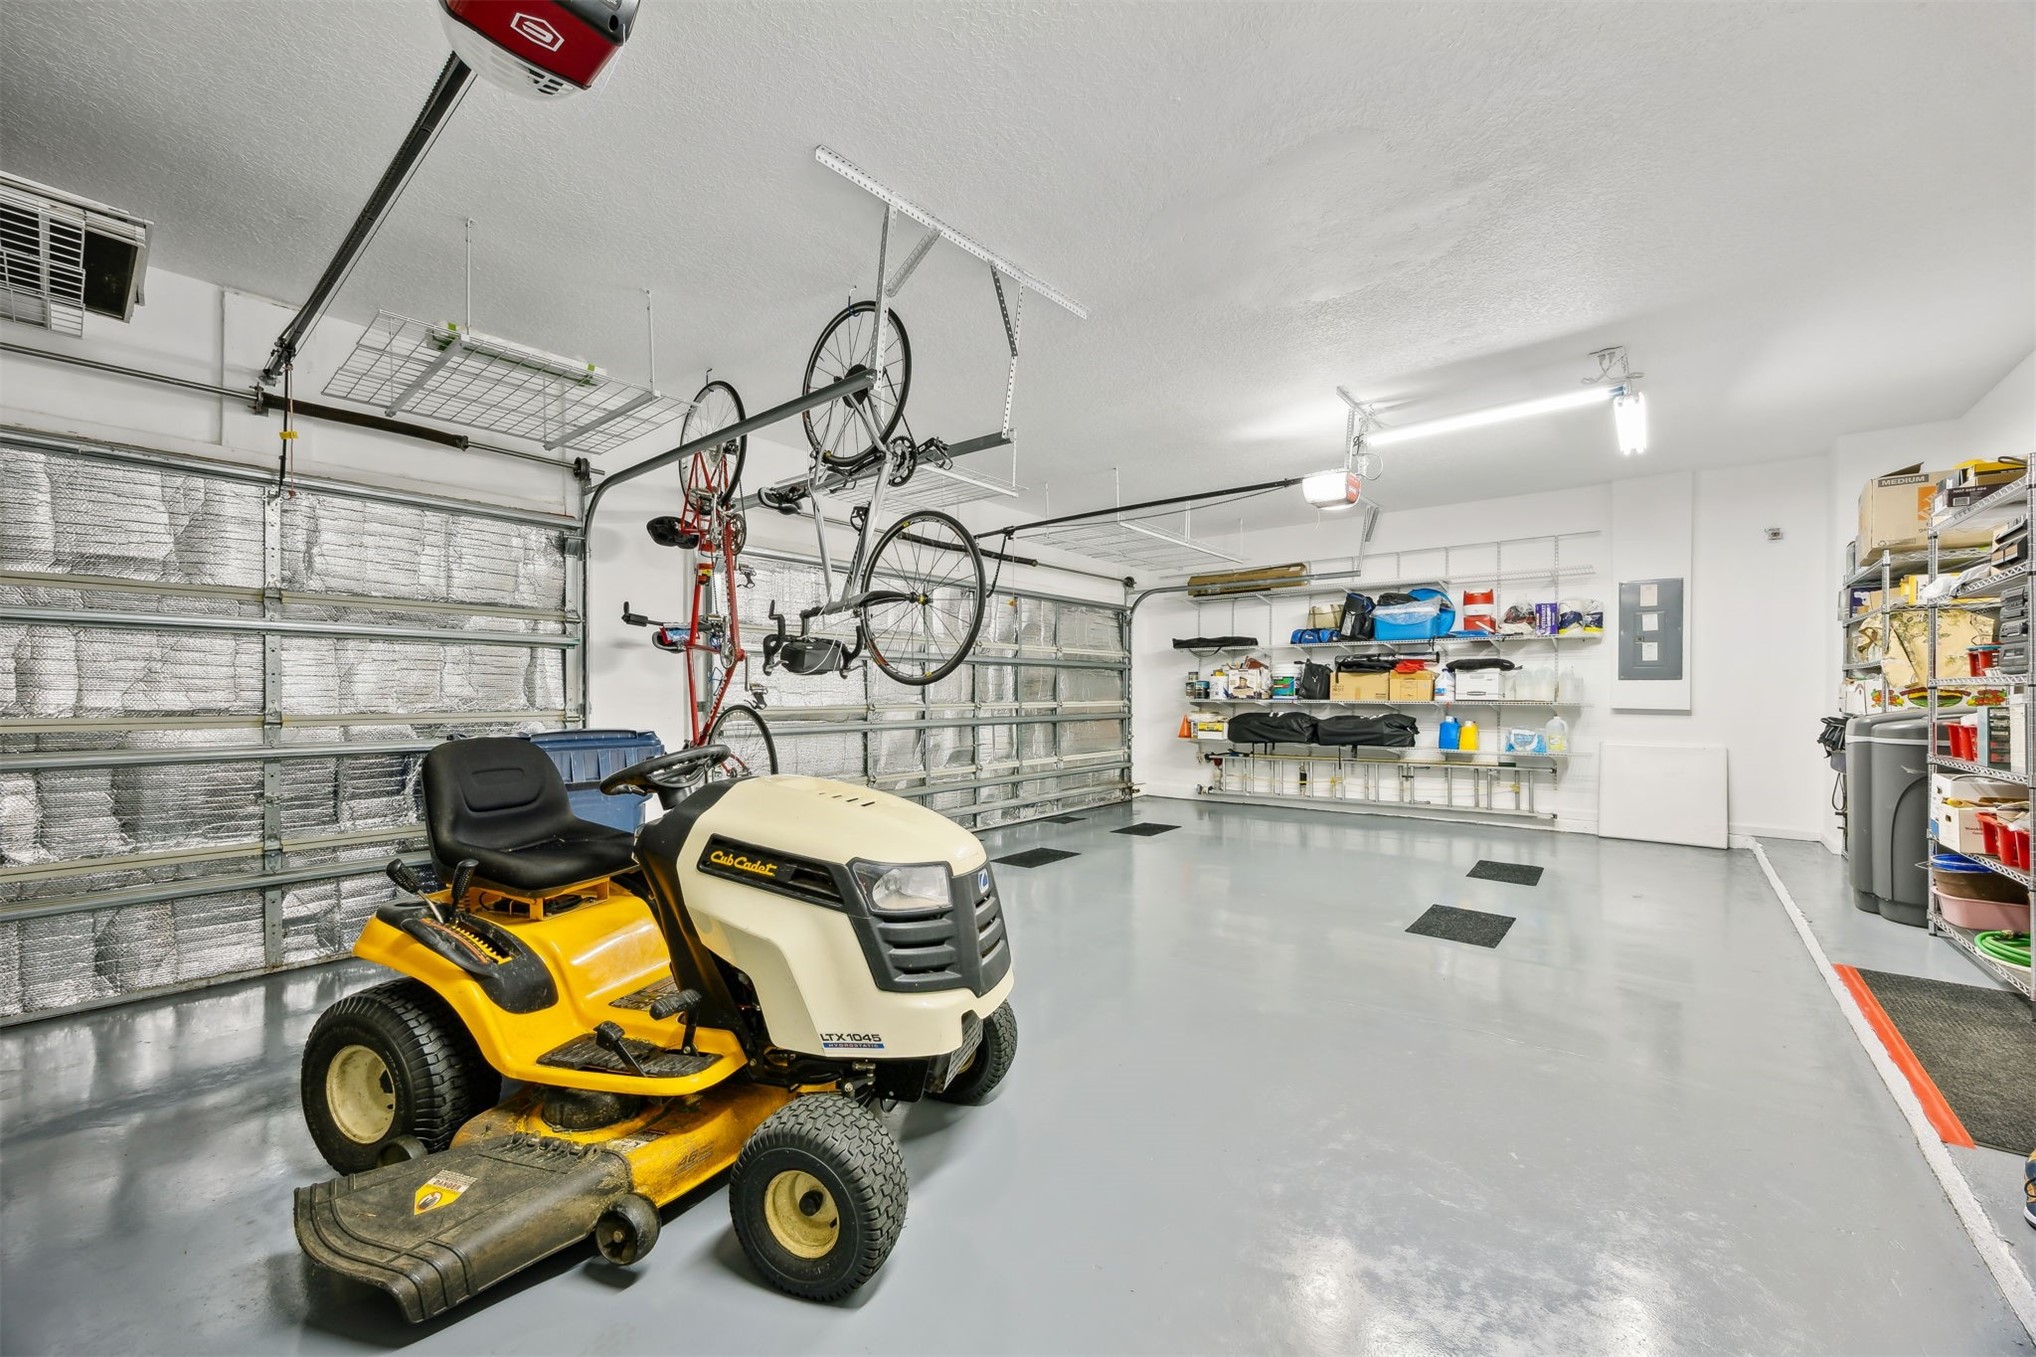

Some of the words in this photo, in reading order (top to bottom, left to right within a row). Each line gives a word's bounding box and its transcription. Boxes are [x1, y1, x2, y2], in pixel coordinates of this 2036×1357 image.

[1881, 475, 1925, 486] MEDIUM
[710, 850, 734, 866] Cub
[734, 856, 778, 877] Cadet
[820, 1033, 846, 1042] LTX
[847, 1033, 882, 1042] 1045
